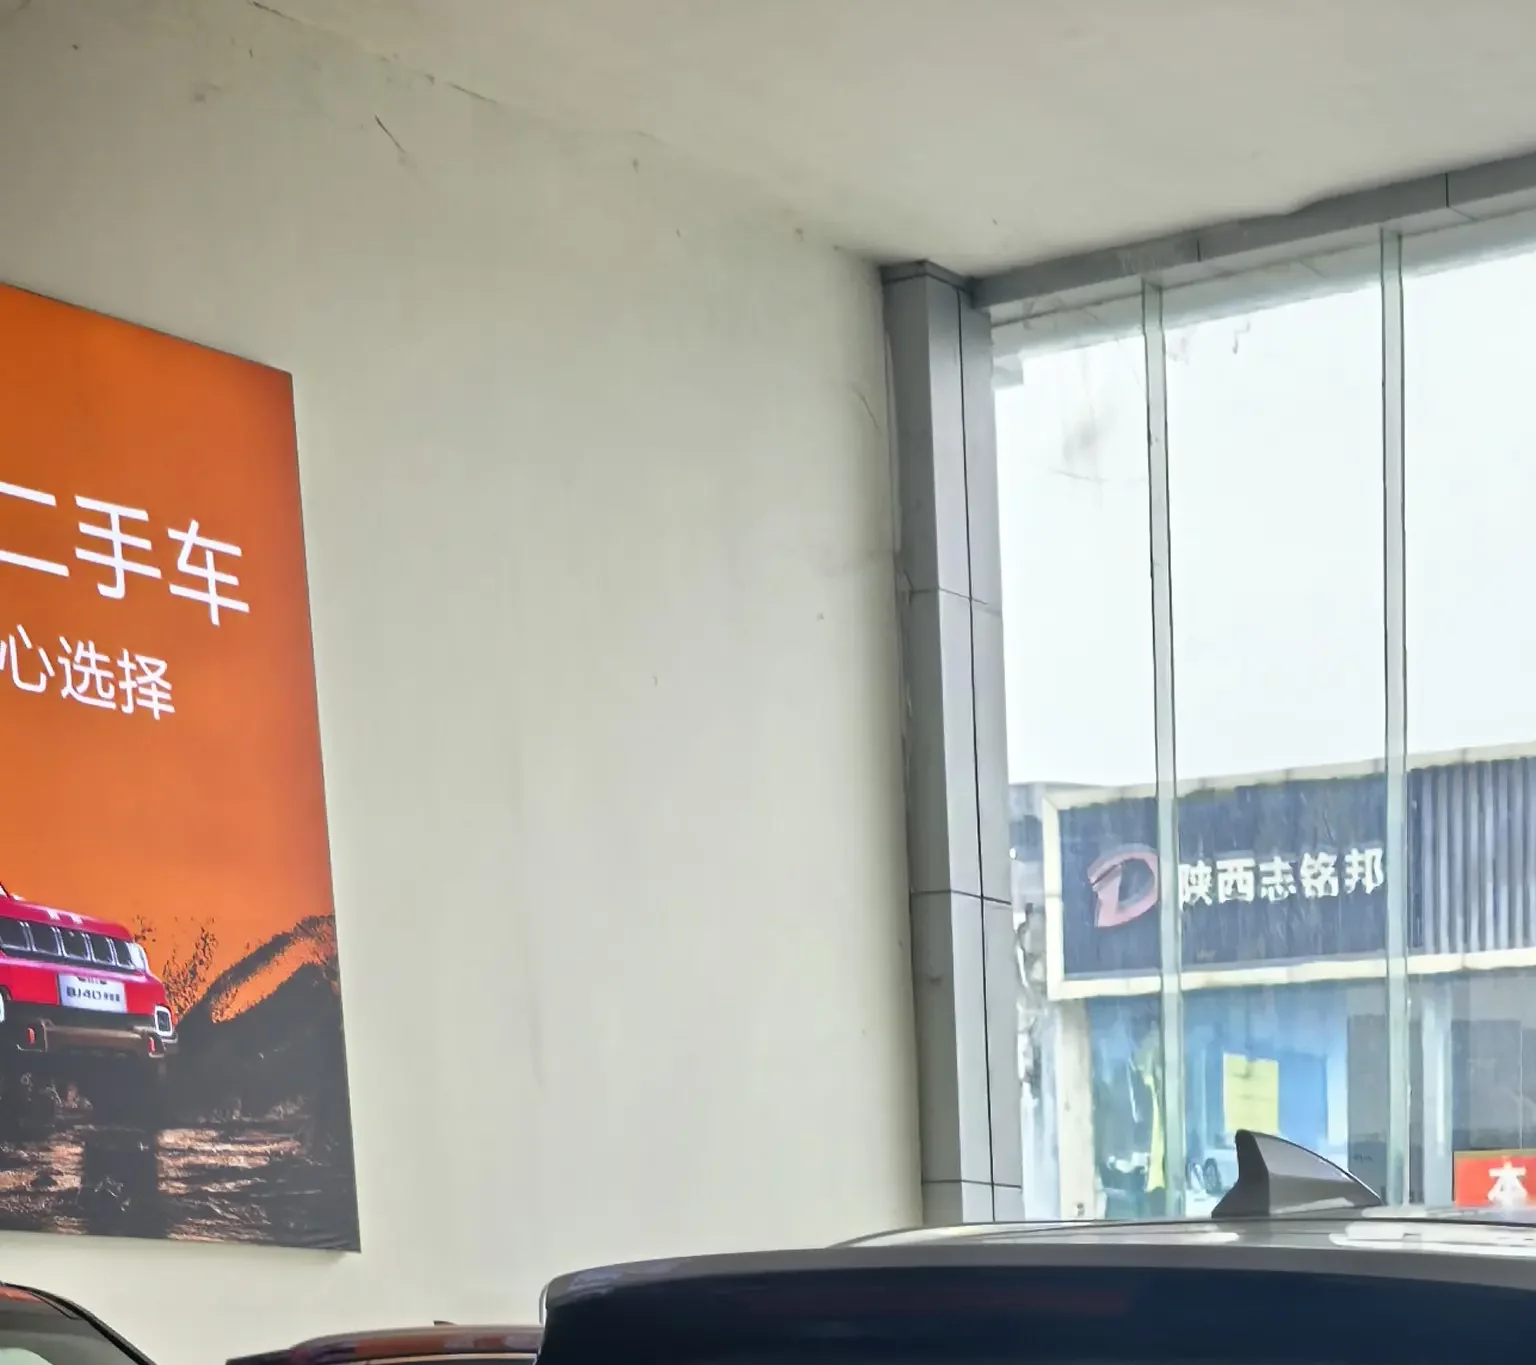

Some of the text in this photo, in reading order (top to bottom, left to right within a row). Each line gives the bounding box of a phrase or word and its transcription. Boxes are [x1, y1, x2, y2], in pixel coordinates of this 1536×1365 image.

[0, 481, 250, 627] 二手车
[0, 624, 175, 720] 心选择
[1178, 847, 1384, 910] 陕西志铭邦
